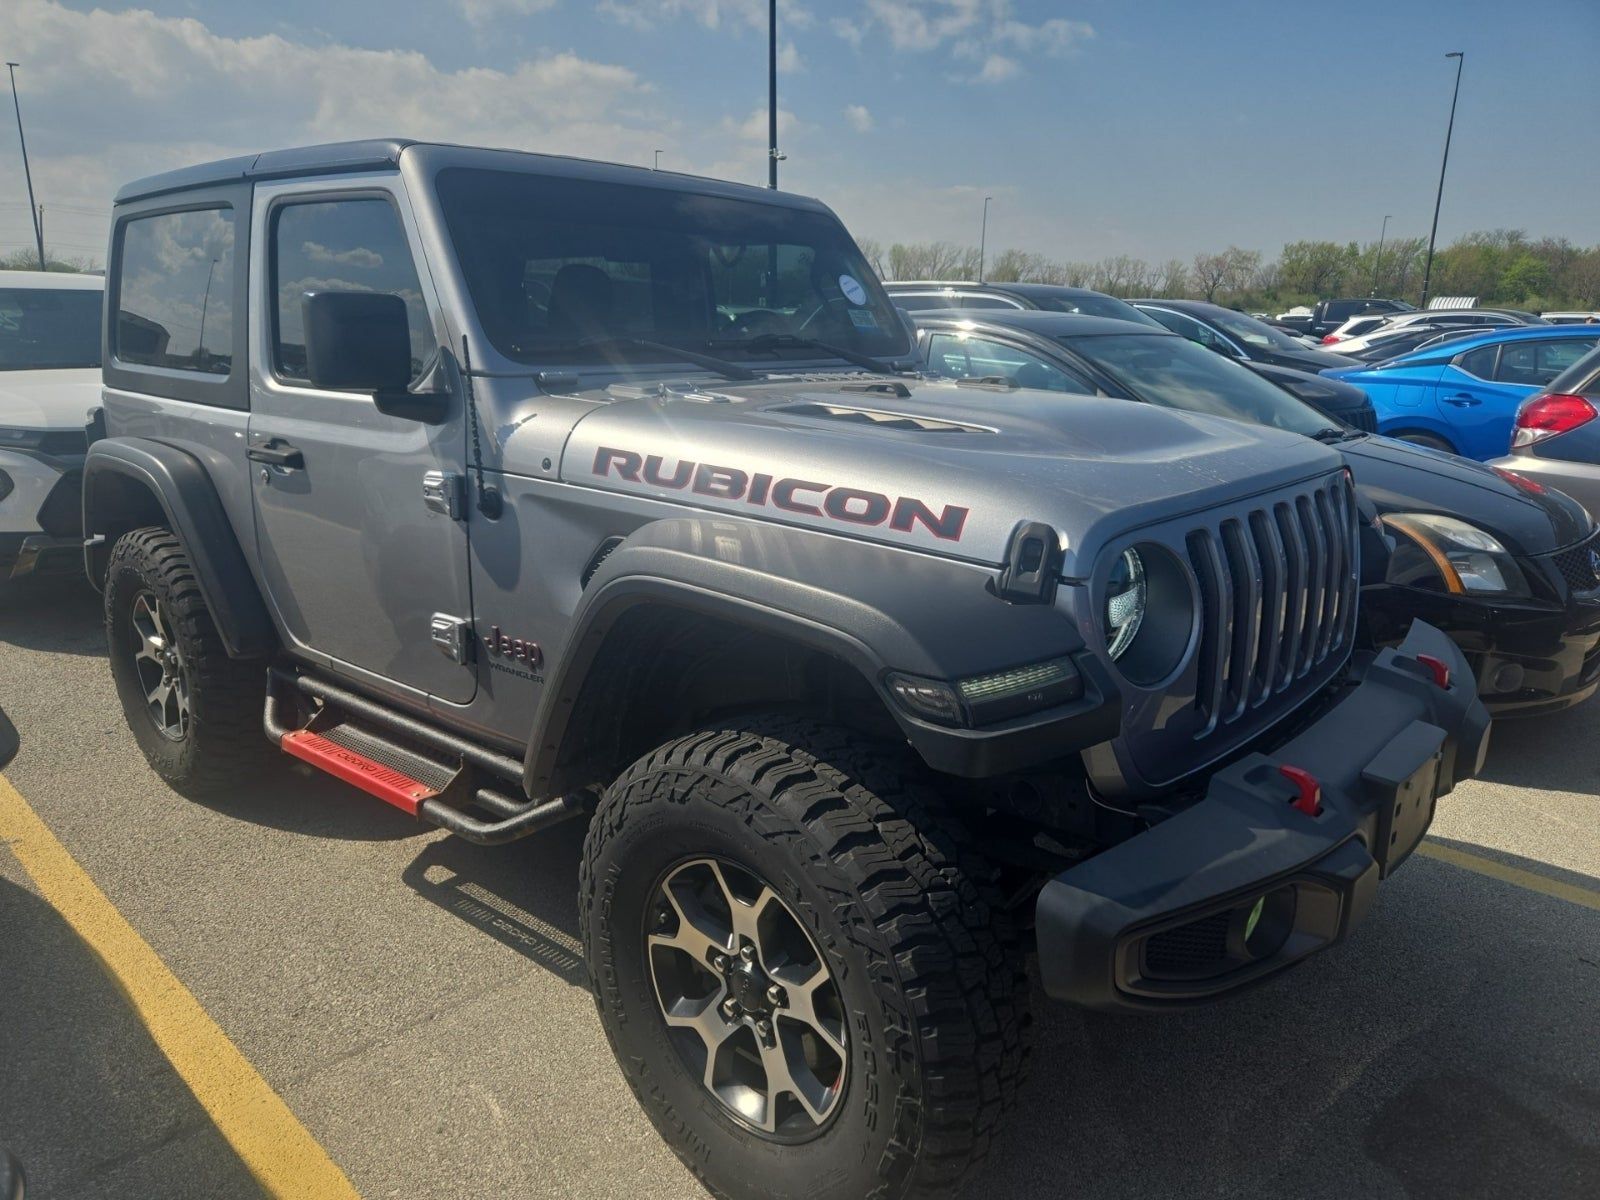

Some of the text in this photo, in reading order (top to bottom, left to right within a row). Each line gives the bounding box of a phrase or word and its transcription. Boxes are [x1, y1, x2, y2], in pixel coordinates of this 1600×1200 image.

[591, 446, 970, 542] RUBICON
[484, 625, 545, 675] Jeep
[489, 660, 545, 685] WRANGLER
